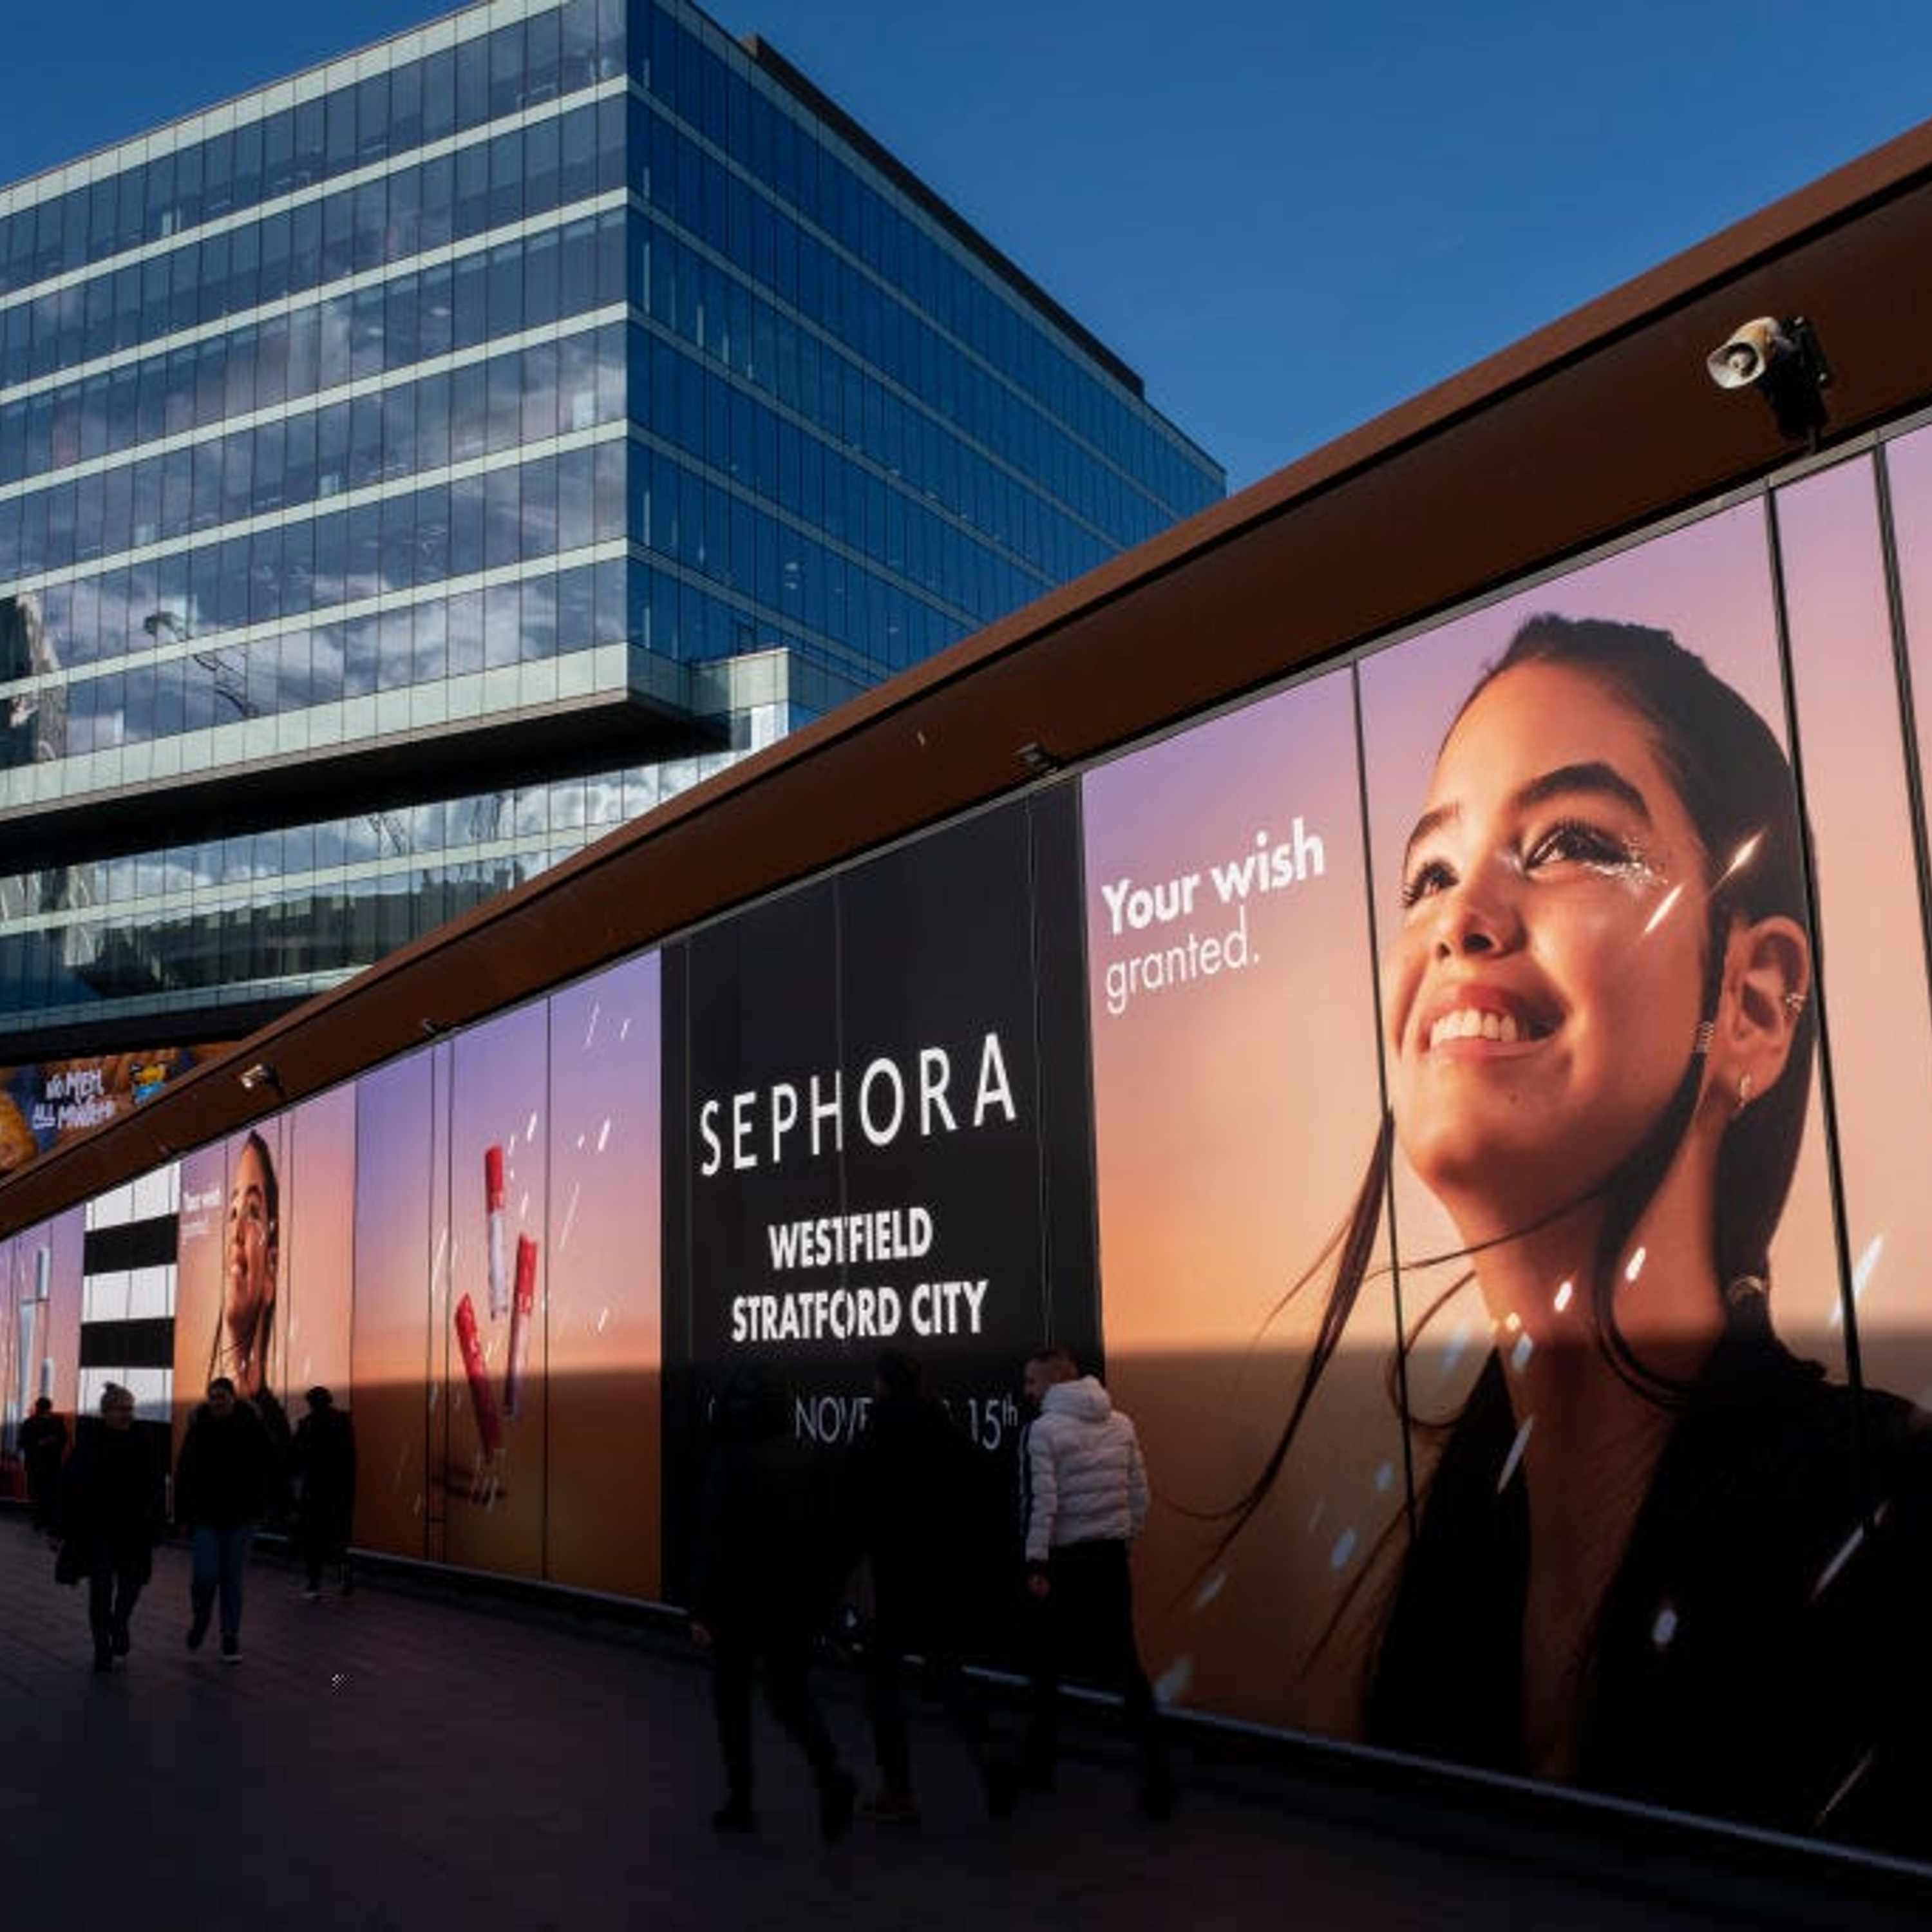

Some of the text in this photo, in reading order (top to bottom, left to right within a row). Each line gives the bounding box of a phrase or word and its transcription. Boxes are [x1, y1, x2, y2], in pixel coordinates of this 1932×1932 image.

[1101, 816, 1325, 935] Your wish
[1106, 904, 1260, 1015] granted.
[699, 1032, 1016, 1177] SEPHORA
[768, 1207, 933, 1271] WESTFIELD
[732, 1280, 989, 1343] STRATFORD CITY
[968, 1394, 1018, 1449] 15th
